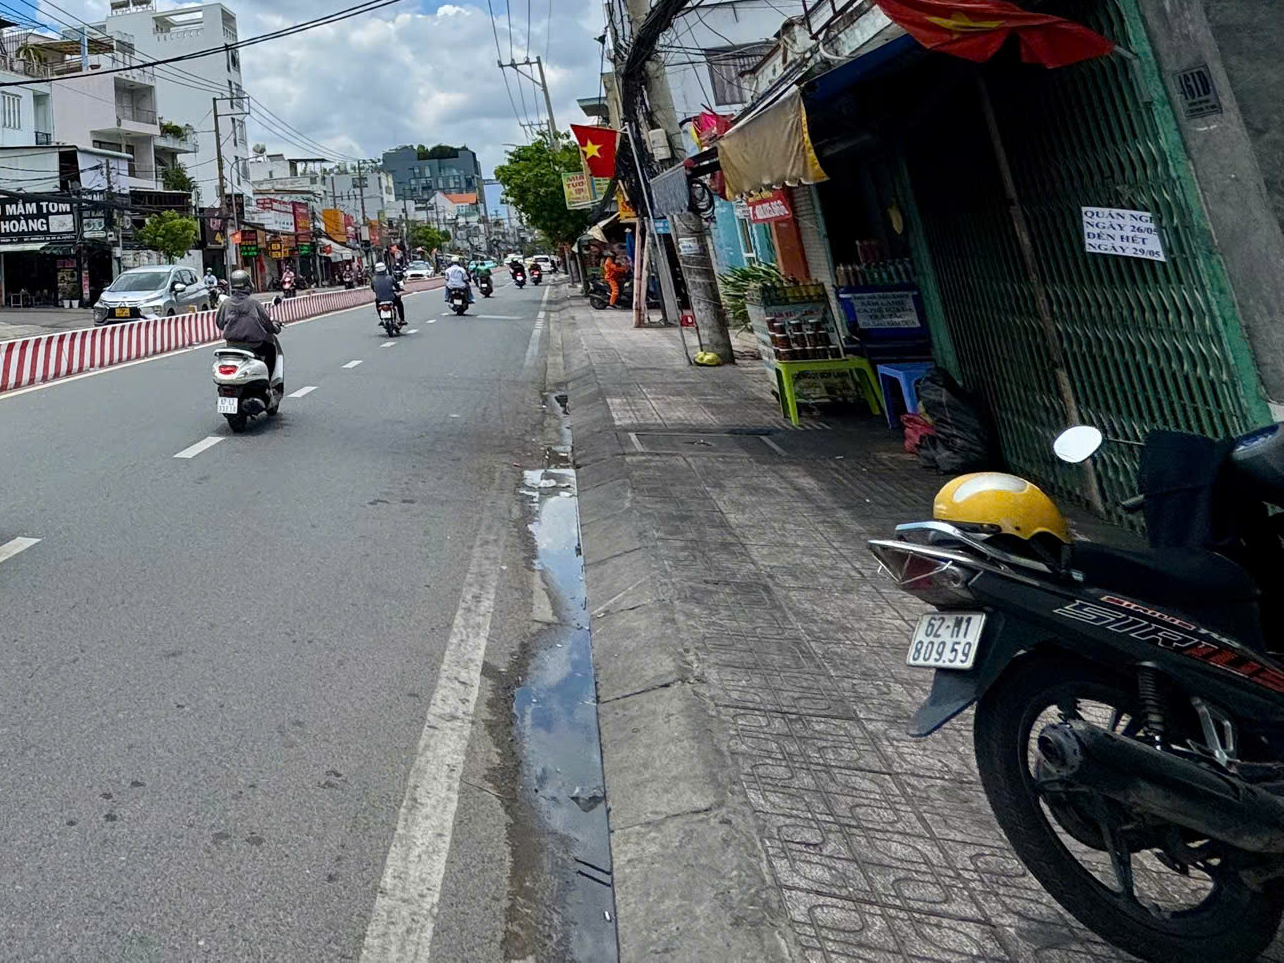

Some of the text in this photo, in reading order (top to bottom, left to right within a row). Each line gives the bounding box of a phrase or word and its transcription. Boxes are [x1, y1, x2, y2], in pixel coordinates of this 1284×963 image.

[0, 216, 47, 233] HOÀNG
[1085, 221, 1127, 232] NGÀY
[1087, 242, 1161, 258] NGÀY 29/05
[912, 640, 973, 665] 809.59
